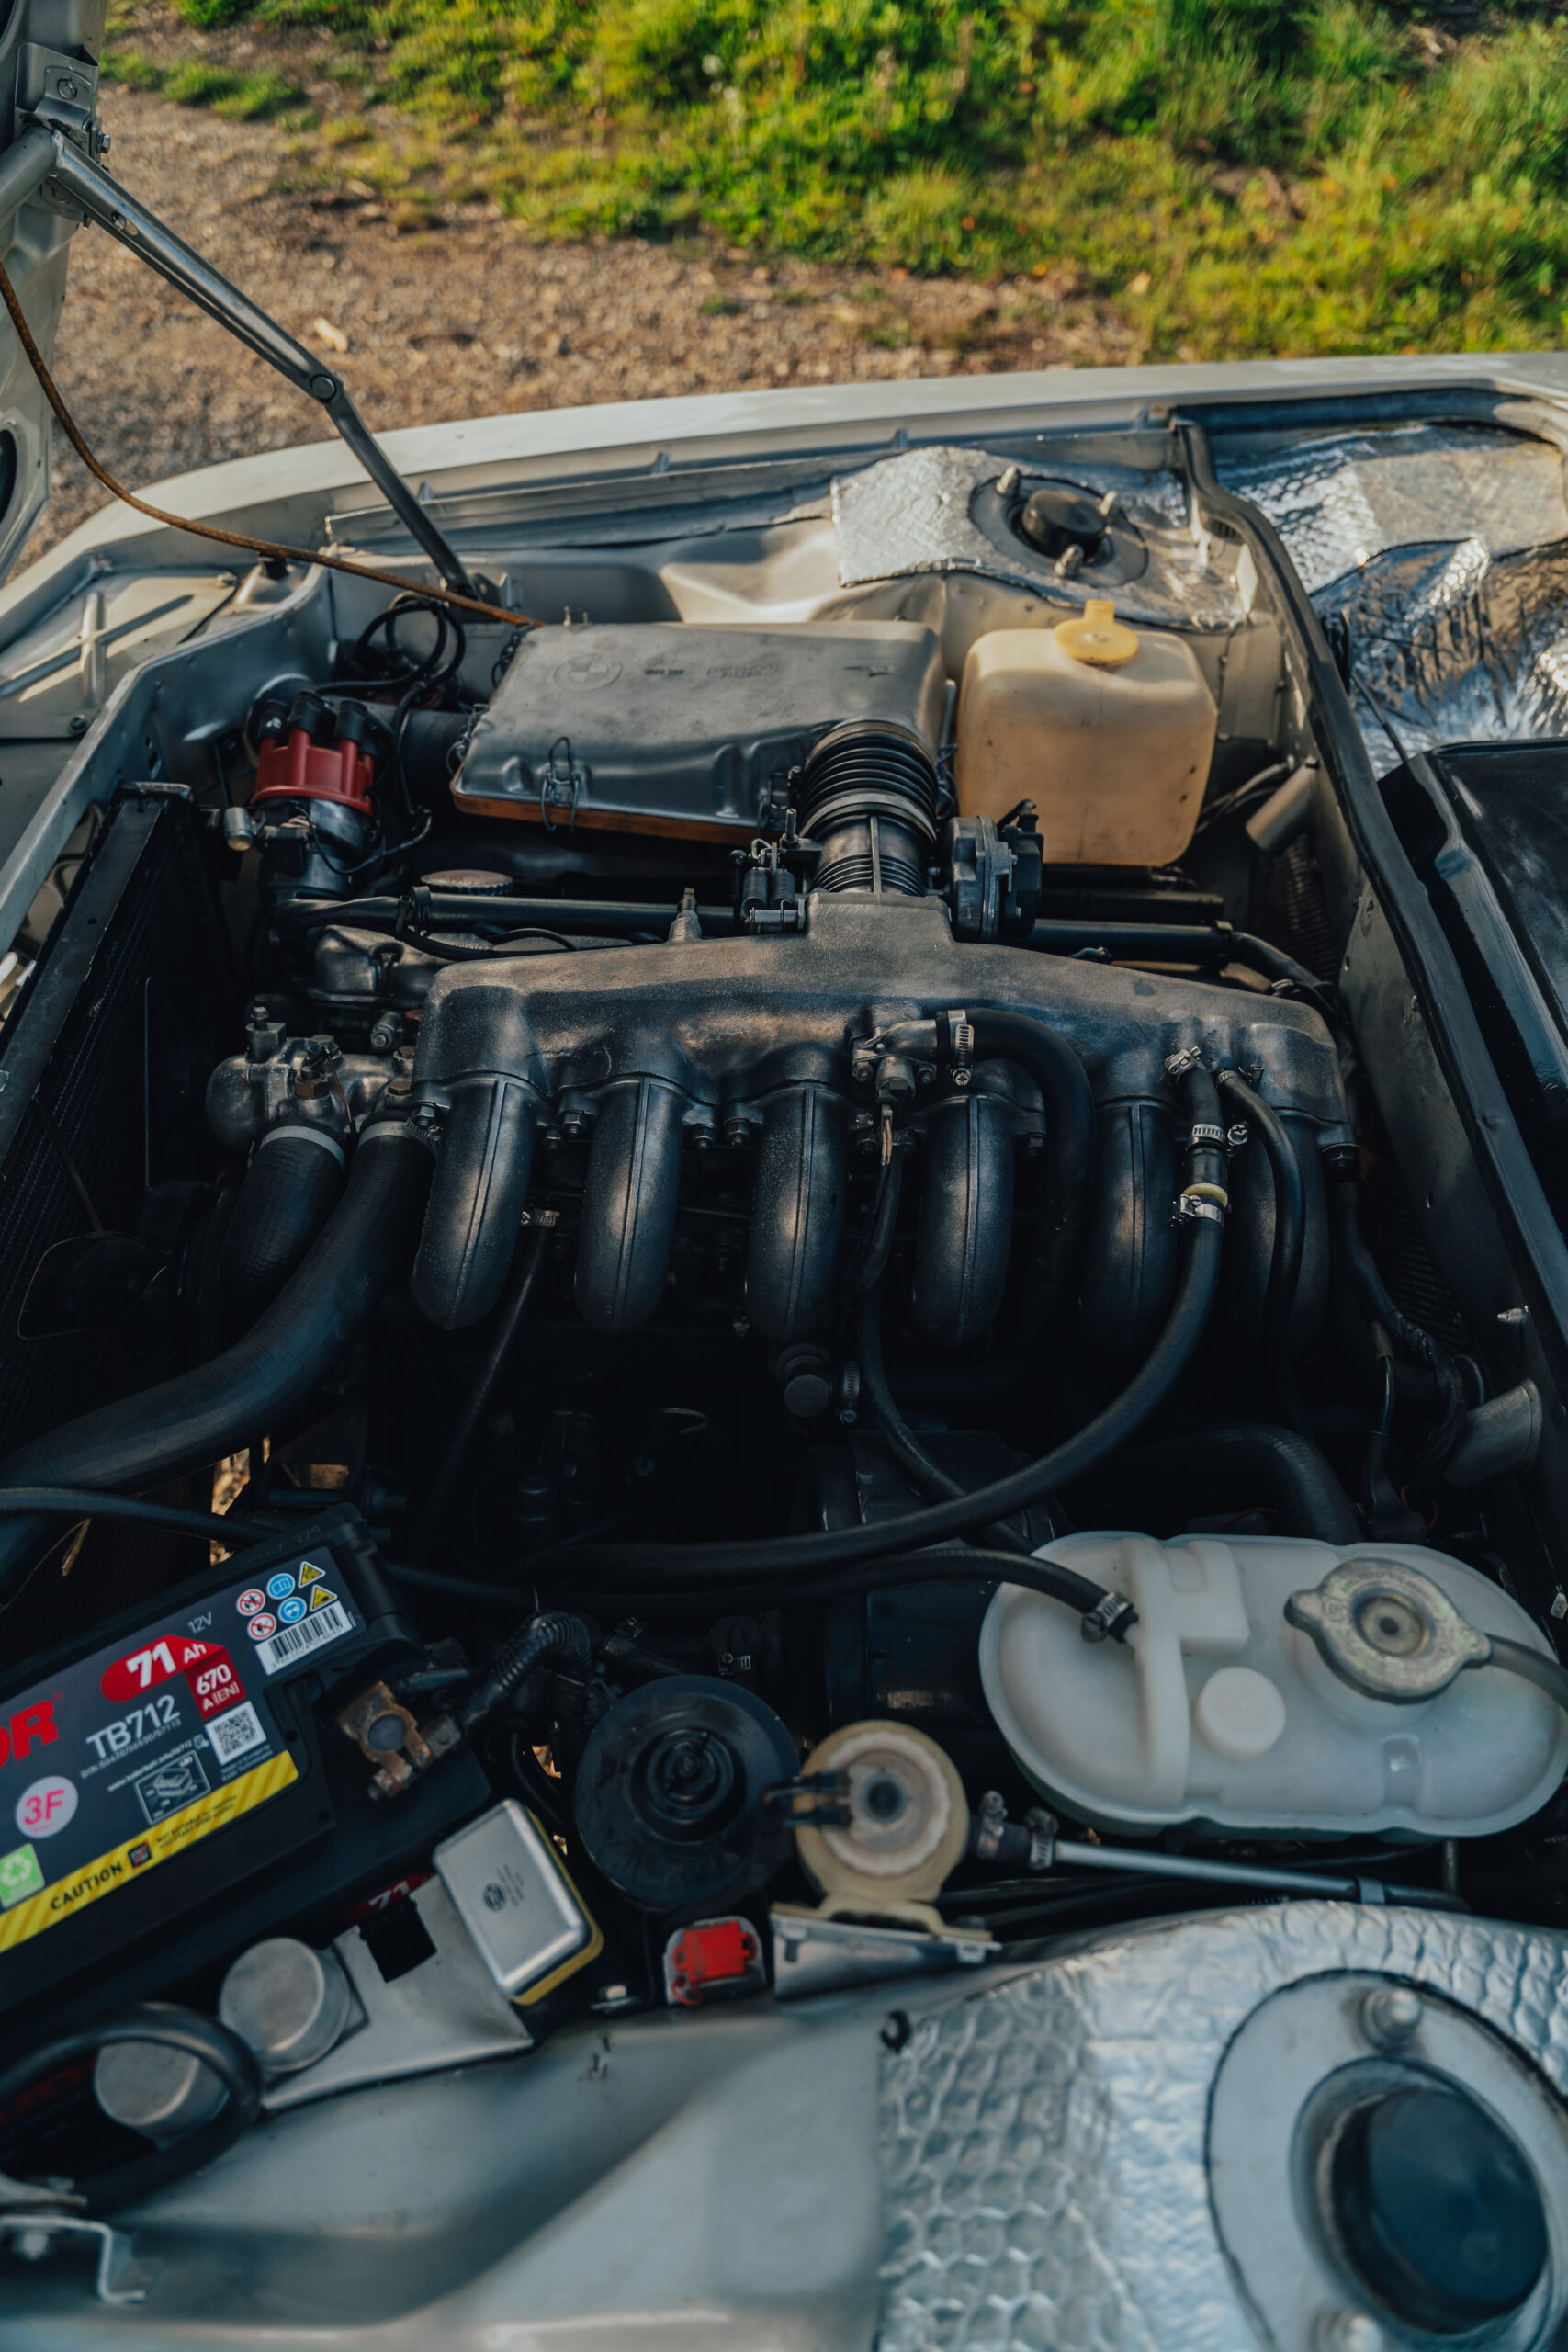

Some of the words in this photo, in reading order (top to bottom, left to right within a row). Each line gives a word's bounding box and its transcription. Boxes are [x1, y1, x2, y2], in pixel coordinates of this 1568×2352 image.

[187, 1611, 213, 1634] 12V
[126, 1642, 176, 1688] 71
[183, 1643, 207, 1665] Ah
[197, 1664, 231, 1695] 670
[202, 1697, 214, 1711] A
[85, 1694, 181, 1758] TB712
[24, 1789, 65, 1825] 3F
[51, 1861, 123, 1910] CAUTION
